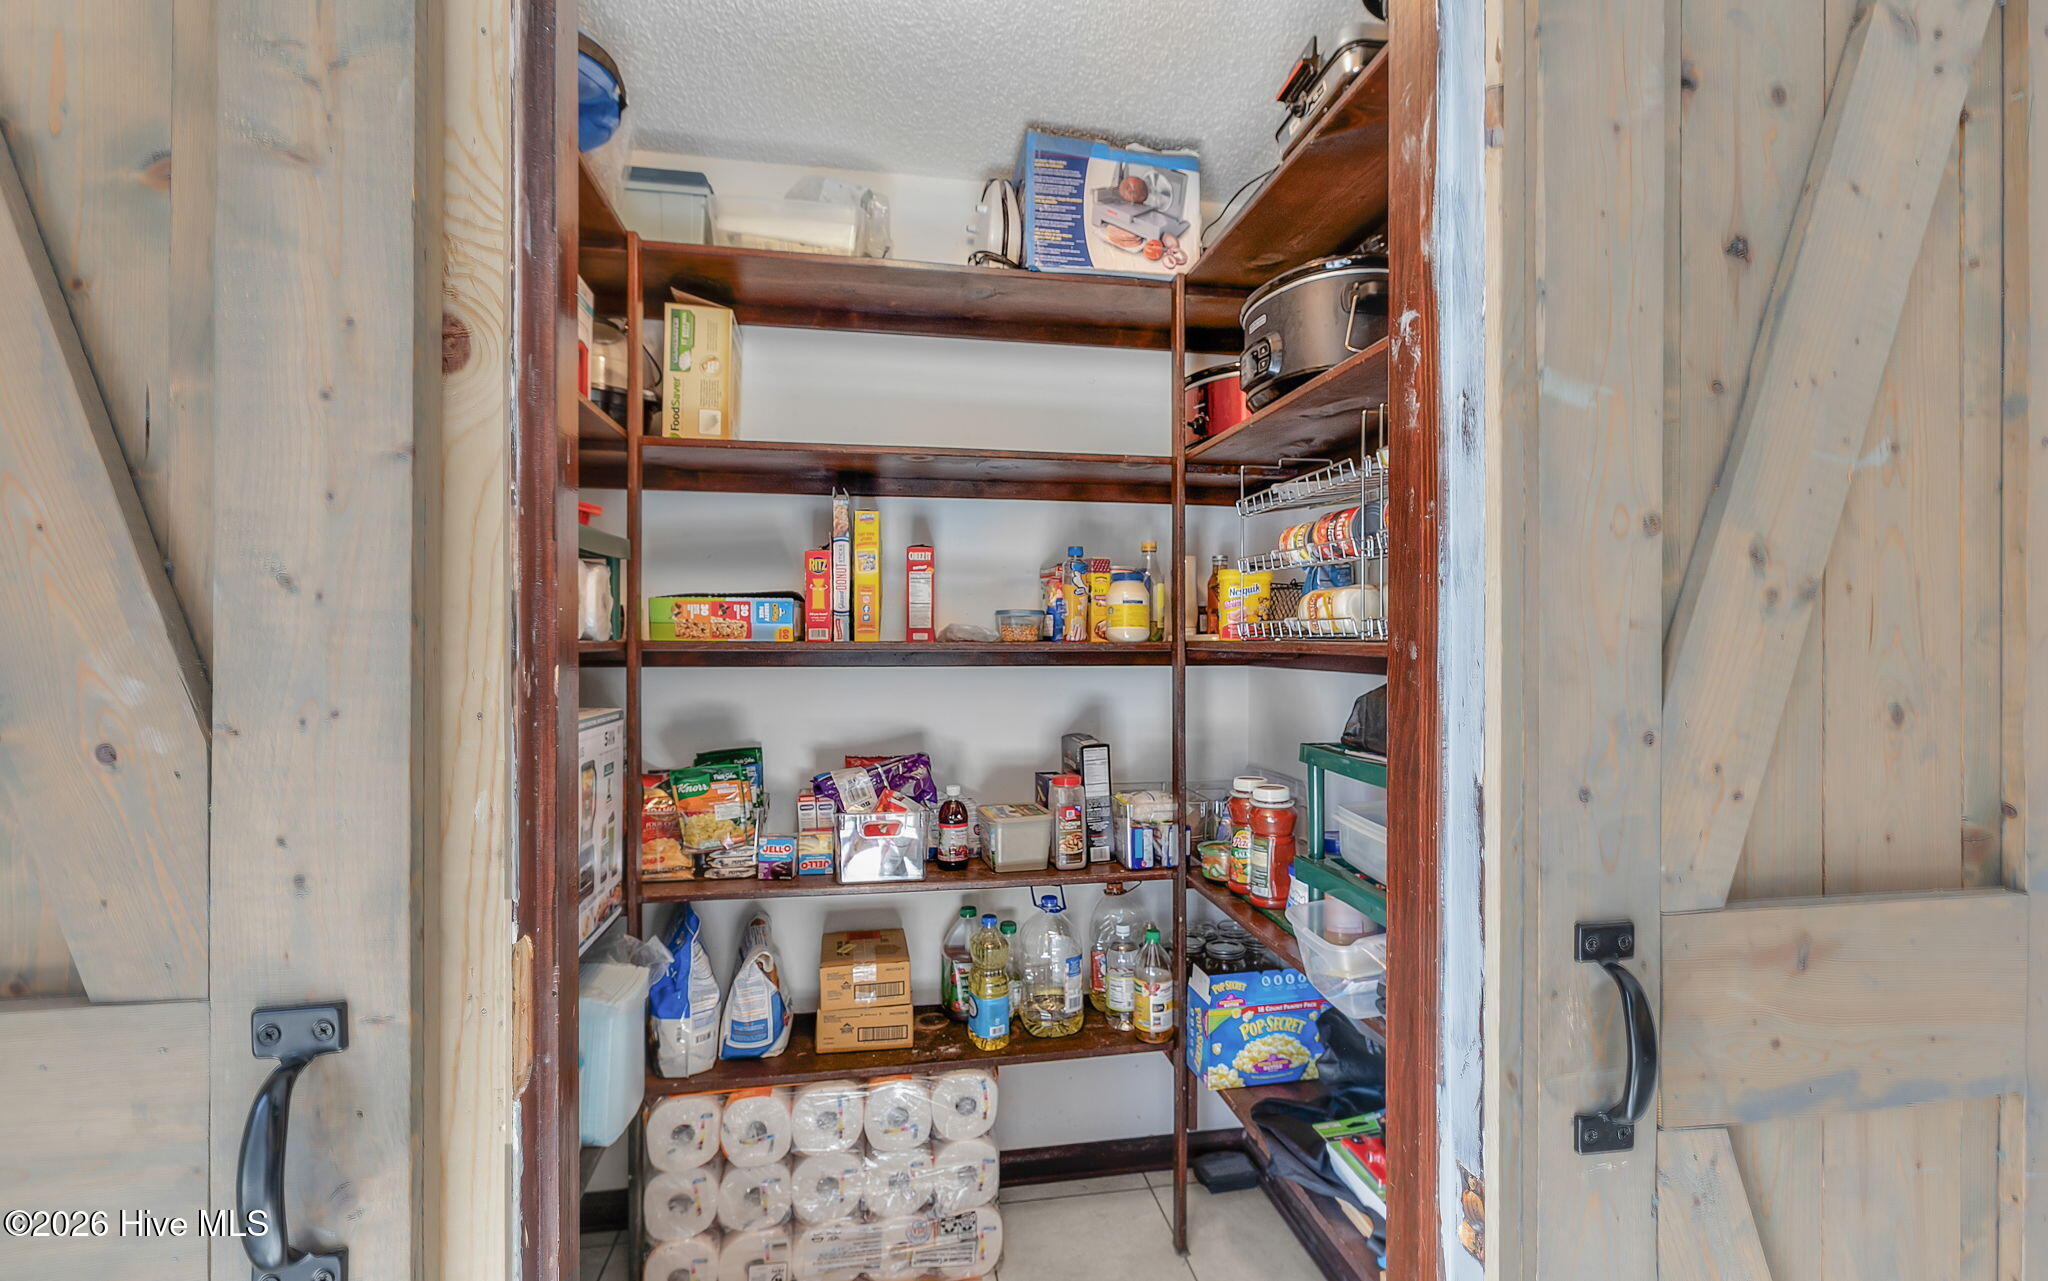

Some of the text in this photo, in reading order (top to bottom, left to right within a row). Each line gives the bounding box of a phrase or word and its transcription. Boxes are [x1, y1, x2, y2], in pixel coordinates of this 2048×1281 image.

[670, 376, 681, 431] FoodSaver
[809, 558, 828, 572] RITZ
[836, 564, 848, 590] DONUT
[677, 783, 709, 794] Knorr
